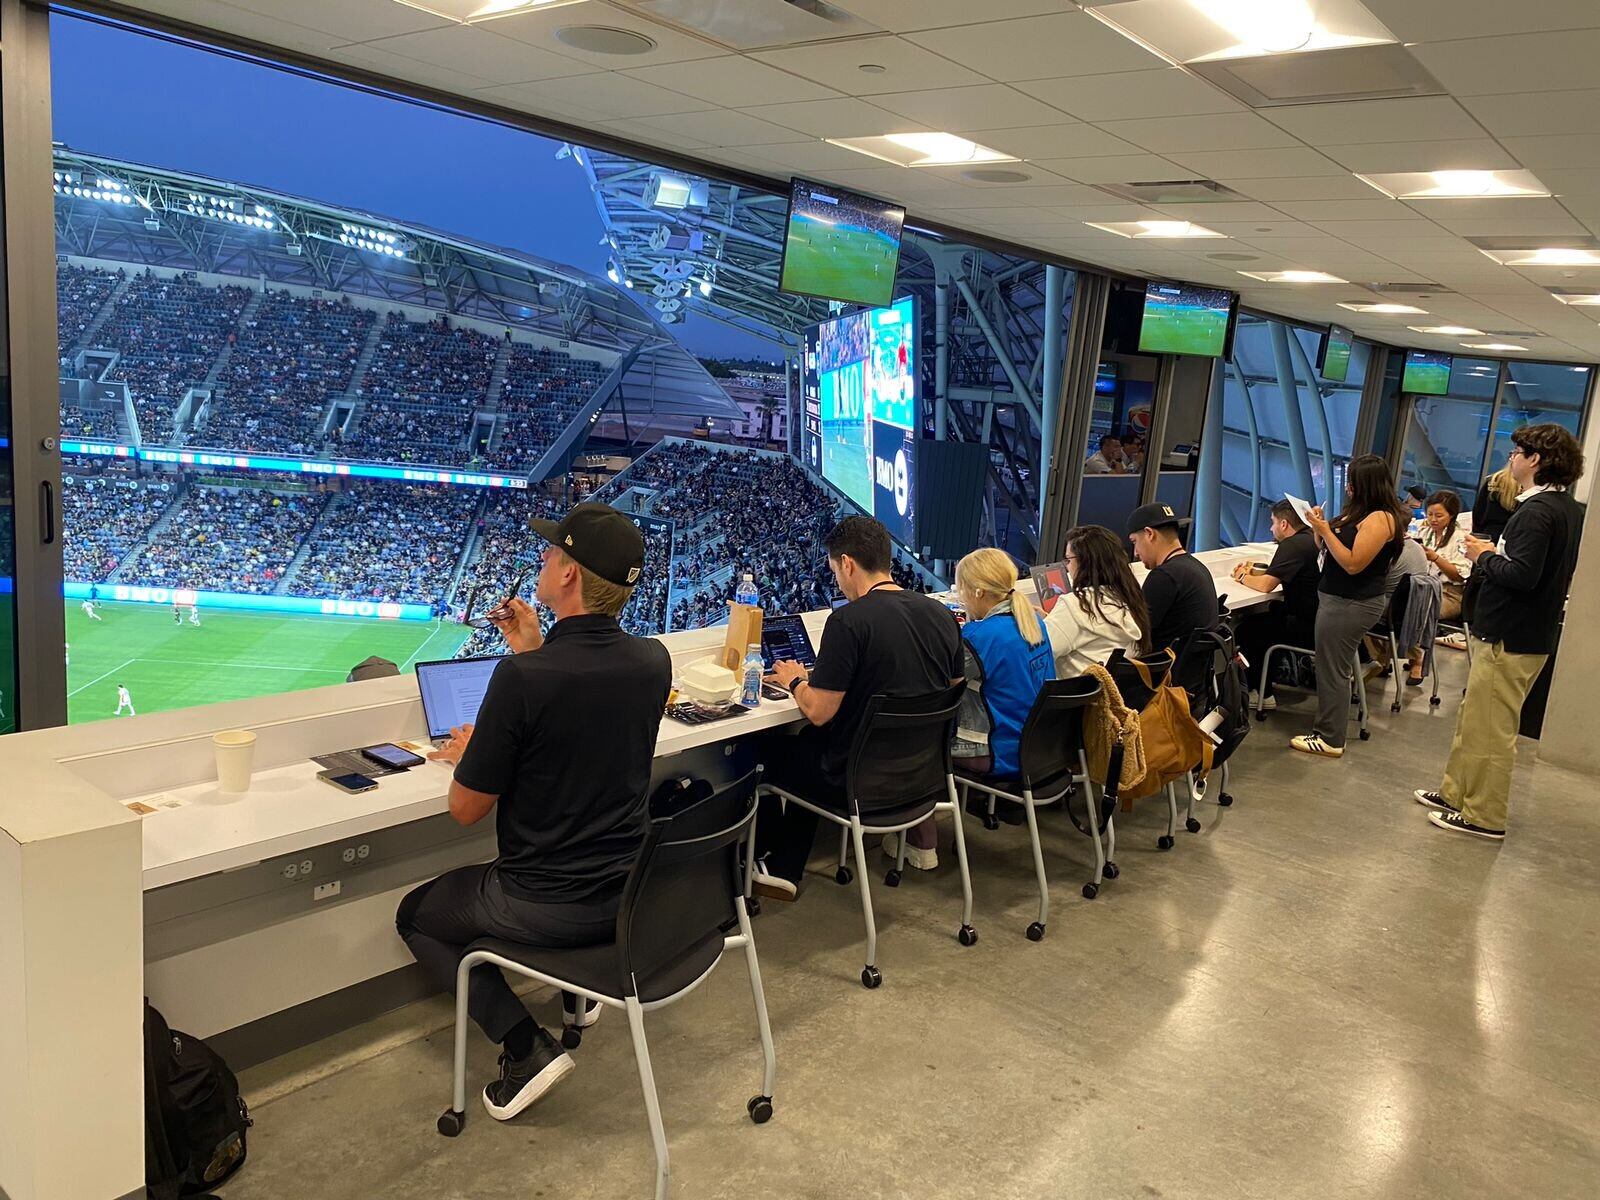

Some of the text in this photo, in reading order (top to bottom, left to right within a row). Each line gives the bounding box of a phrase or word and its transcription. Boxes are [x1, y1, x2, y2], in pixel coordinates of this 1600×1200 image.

[80, 443, 113, 455] BMO
[146, 452, 177, 462] BMO
[200, 455, 231, 466] BMO
[876, 456, 894, 491] BMO
[115, 586, 169, 603] BMO
[321, 599, 375, 616] BMO
